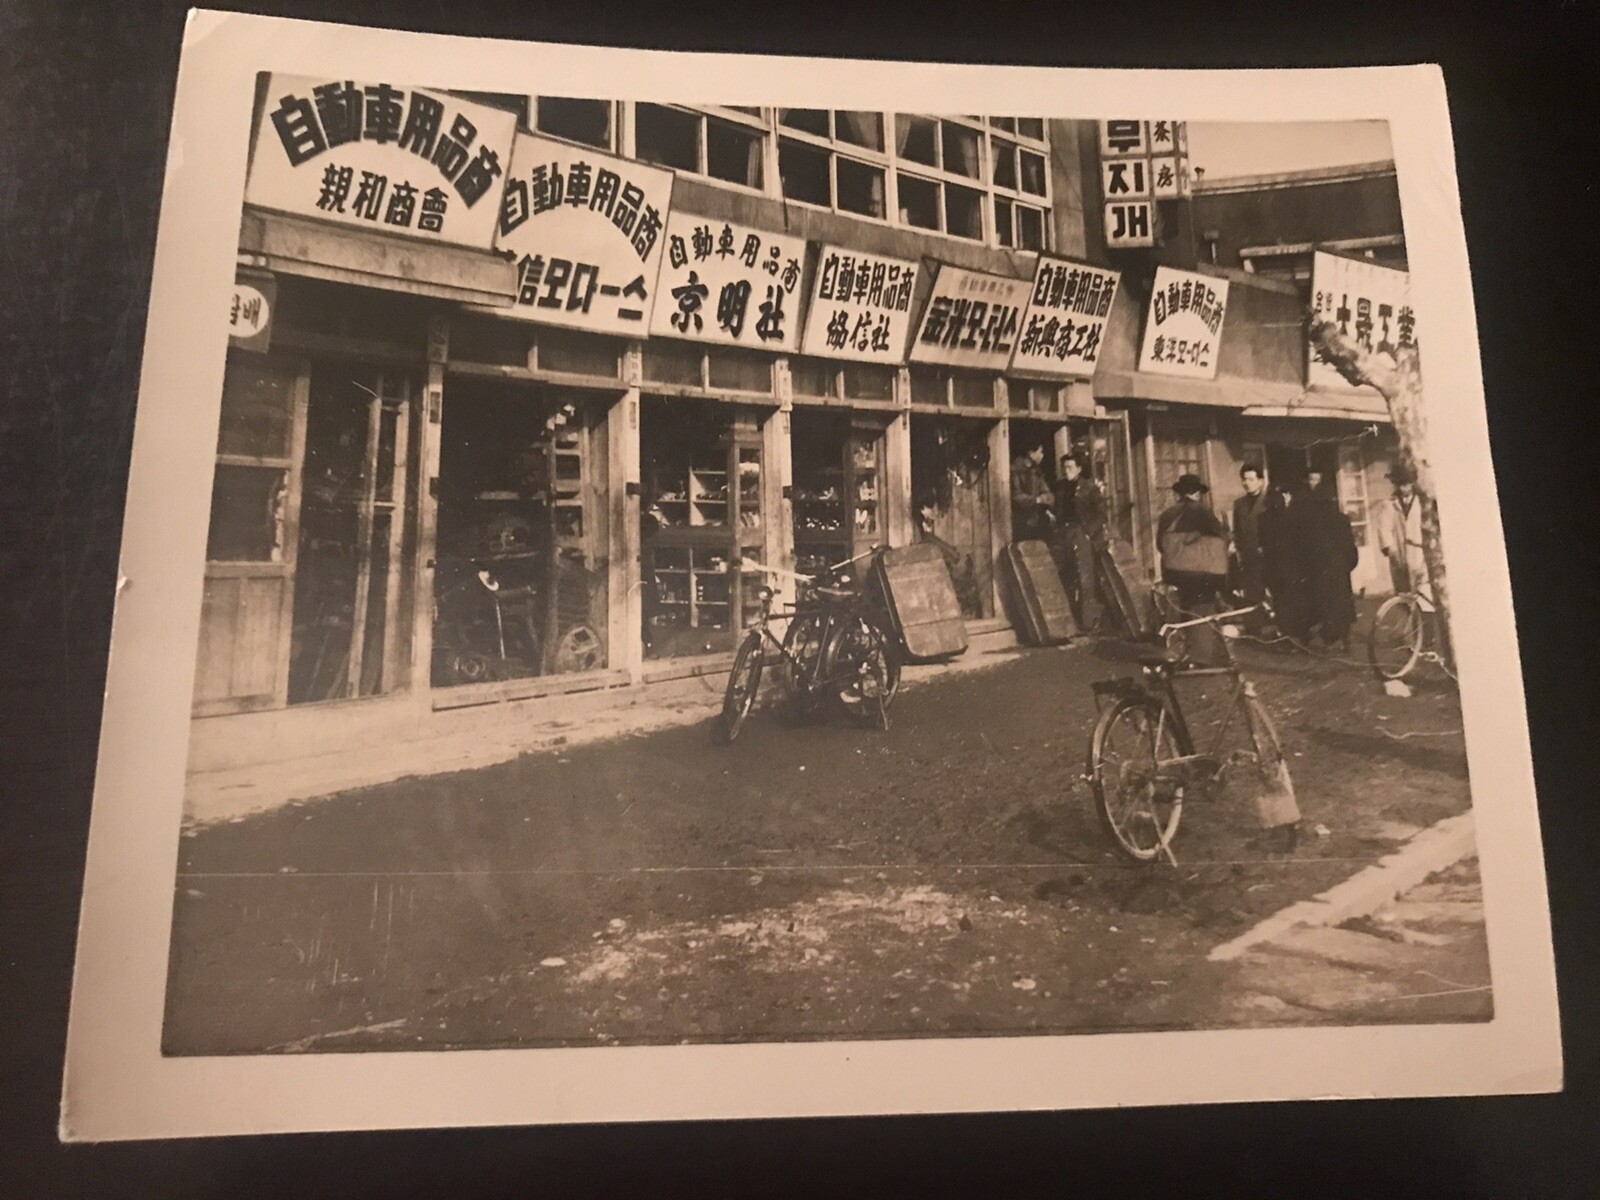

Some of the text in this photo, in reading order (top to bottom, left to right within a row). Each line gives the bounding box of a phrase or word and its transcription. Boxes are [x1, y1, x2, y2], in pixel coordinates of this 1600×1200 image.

[270, 80, 502, 208] 自動車用品商
[315, 162, 449, 233] 親和商會
[500, 161, 663, 262] 自動車用品商
[500, 249, 648, 321] 信모다-스
[669, 223, 802, 294] 自動車用品商
[819, 253, 914, 312] 自動車用品商
[1032, 262, 1116, 318] 自動車用品商
[671, 270, 785, 343] 京明社
[1153, 279, 1223, 336] 自動車用品商
